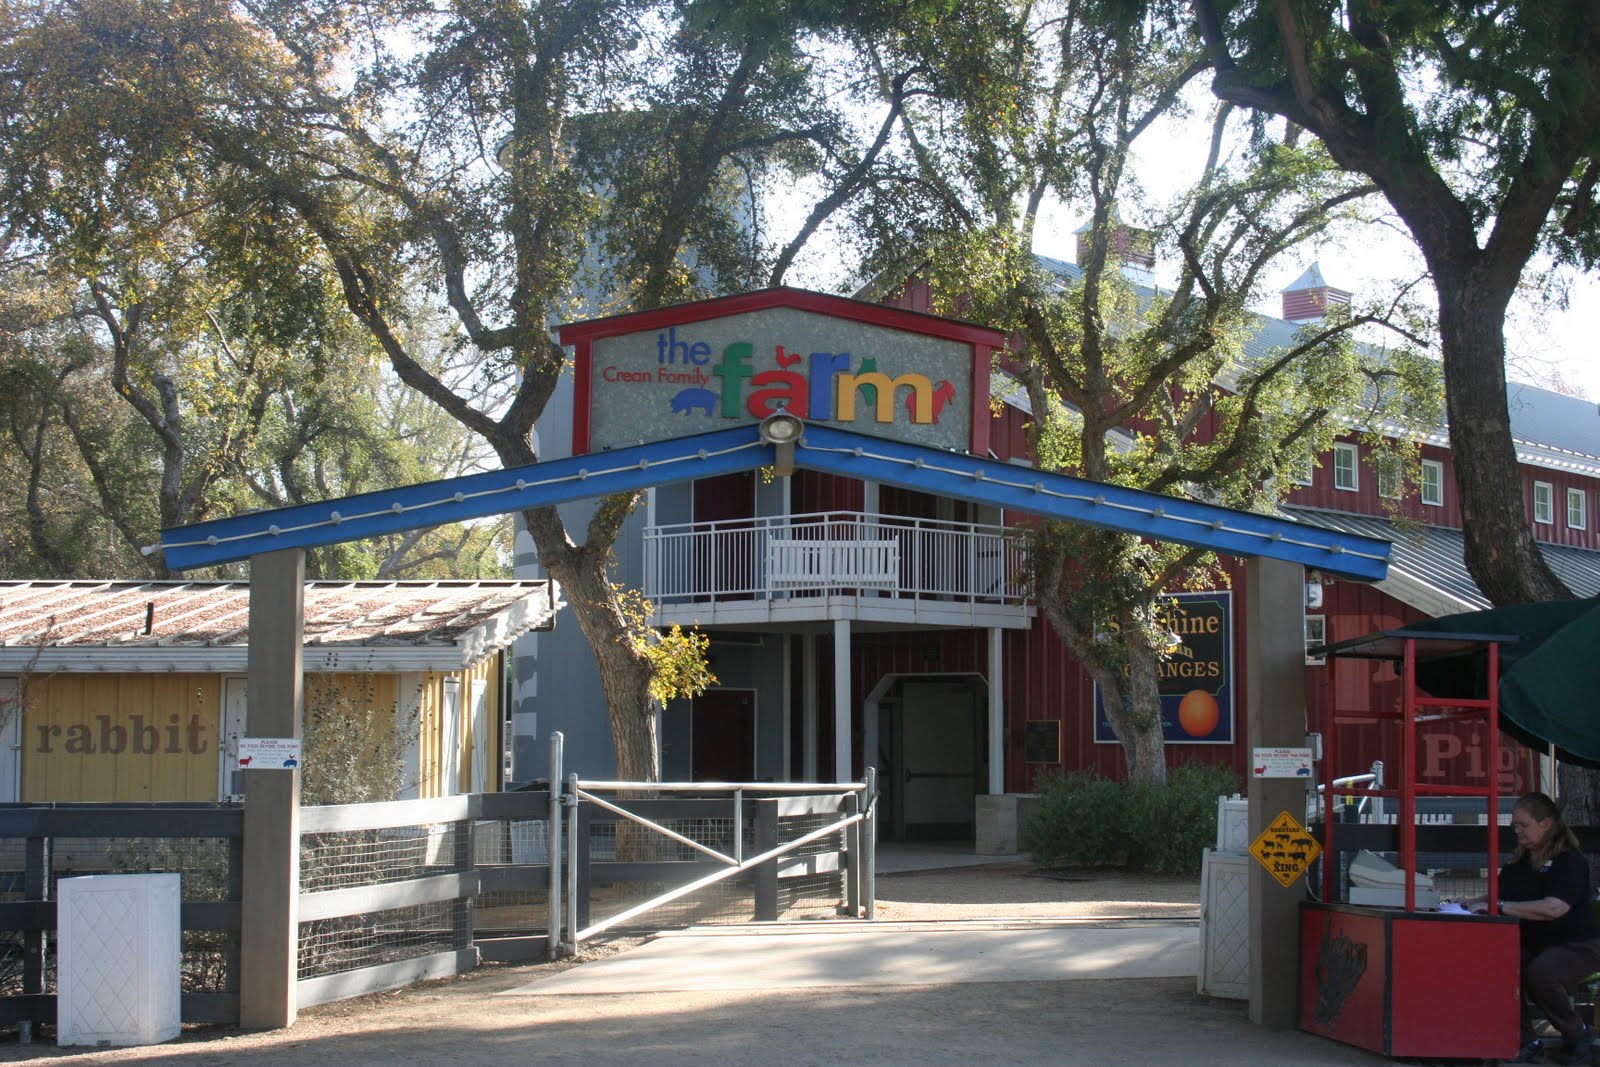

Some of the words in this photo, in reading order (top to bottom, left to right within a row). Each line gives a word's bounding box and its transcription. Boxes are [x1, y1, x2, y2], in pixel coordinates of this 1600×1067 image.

[657, 327, 711, 365] the
[603, 366, 653, 383] Crean
[658, 367, 710, 389] Family
[714, 341, 932, 423] farm
[1124, 661, 1219, 678] OANGES
[37, 713, 208, 755] rabbit
